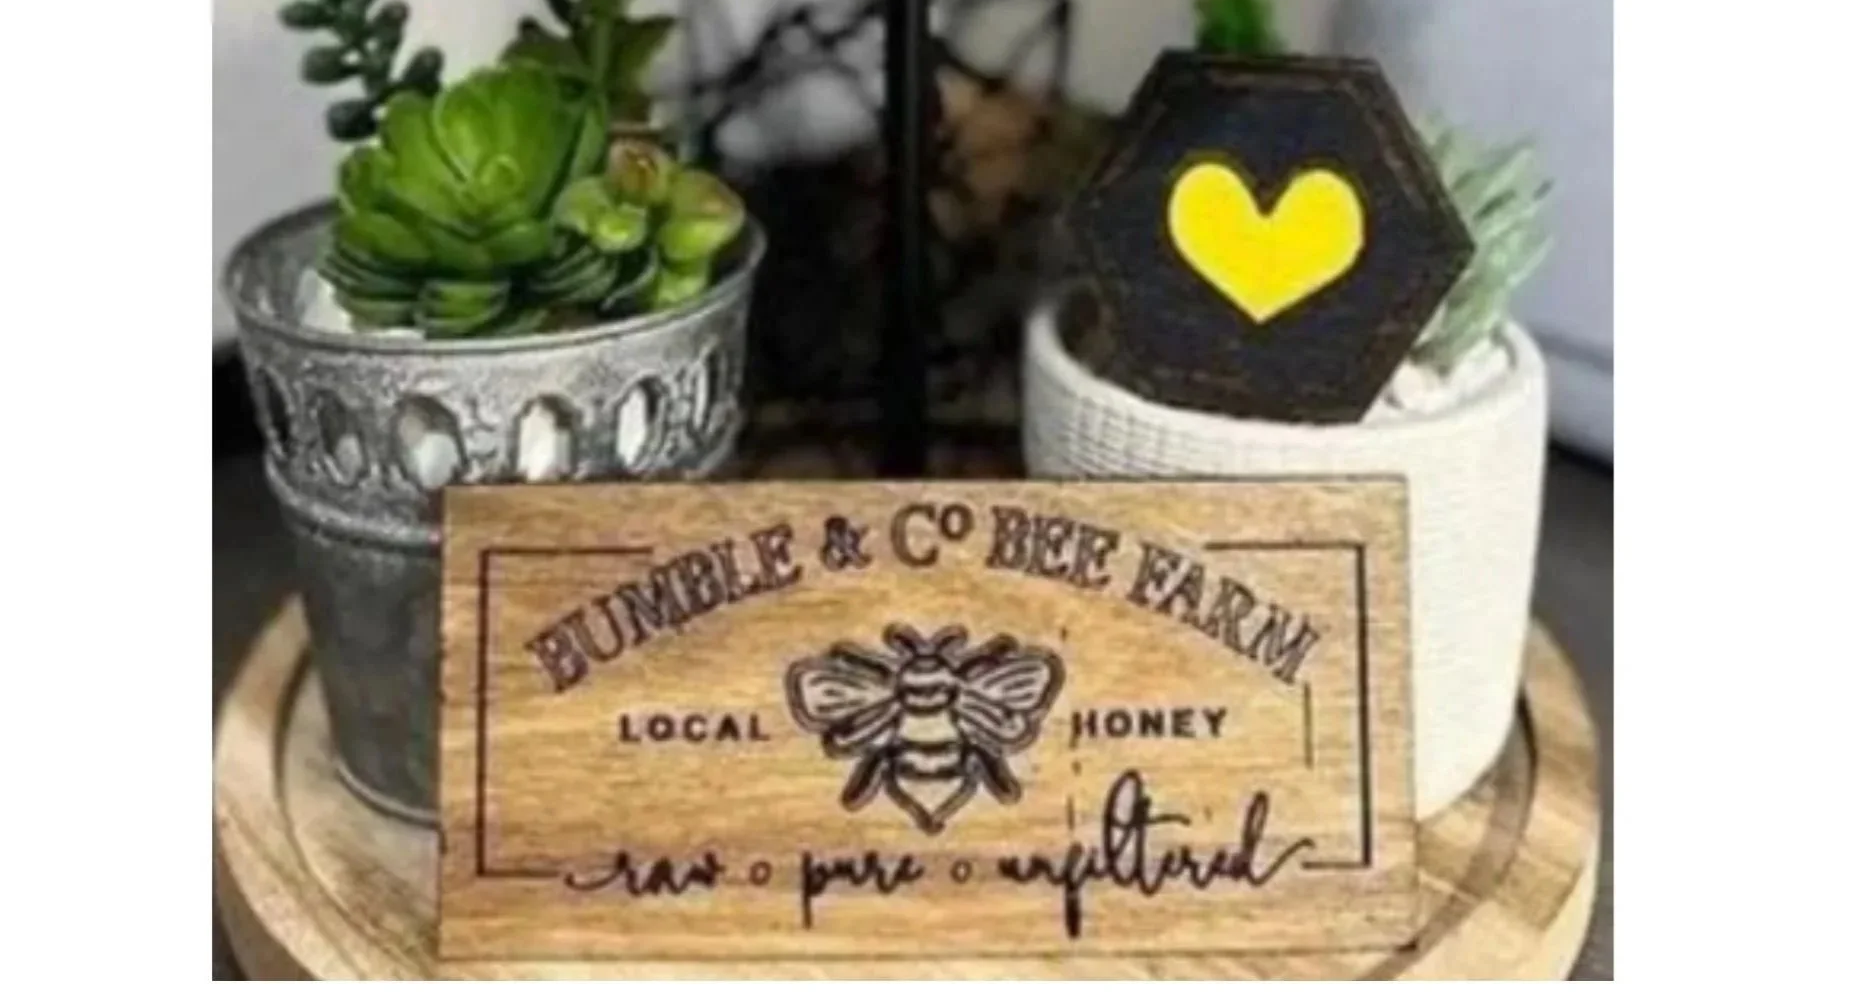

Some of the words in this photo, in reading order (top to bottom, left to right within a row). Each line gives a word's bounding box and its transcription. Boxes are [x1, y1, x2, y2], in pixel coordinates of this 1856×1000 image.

[524, 523, 804, 693] BUMBLE
[821, 515, 873, 568] &
[986, 505, 1119, 590] BEE
[1127, 541, 1320, 685] FARM
[619, 713, 771, 743] LOCAL
[1071, 707, 1229, 741] HONEY
[566, 850, 725, 897] raw
[803, 847, 924, 929] pure
[998, 769, 1315, 938] unfiltered
